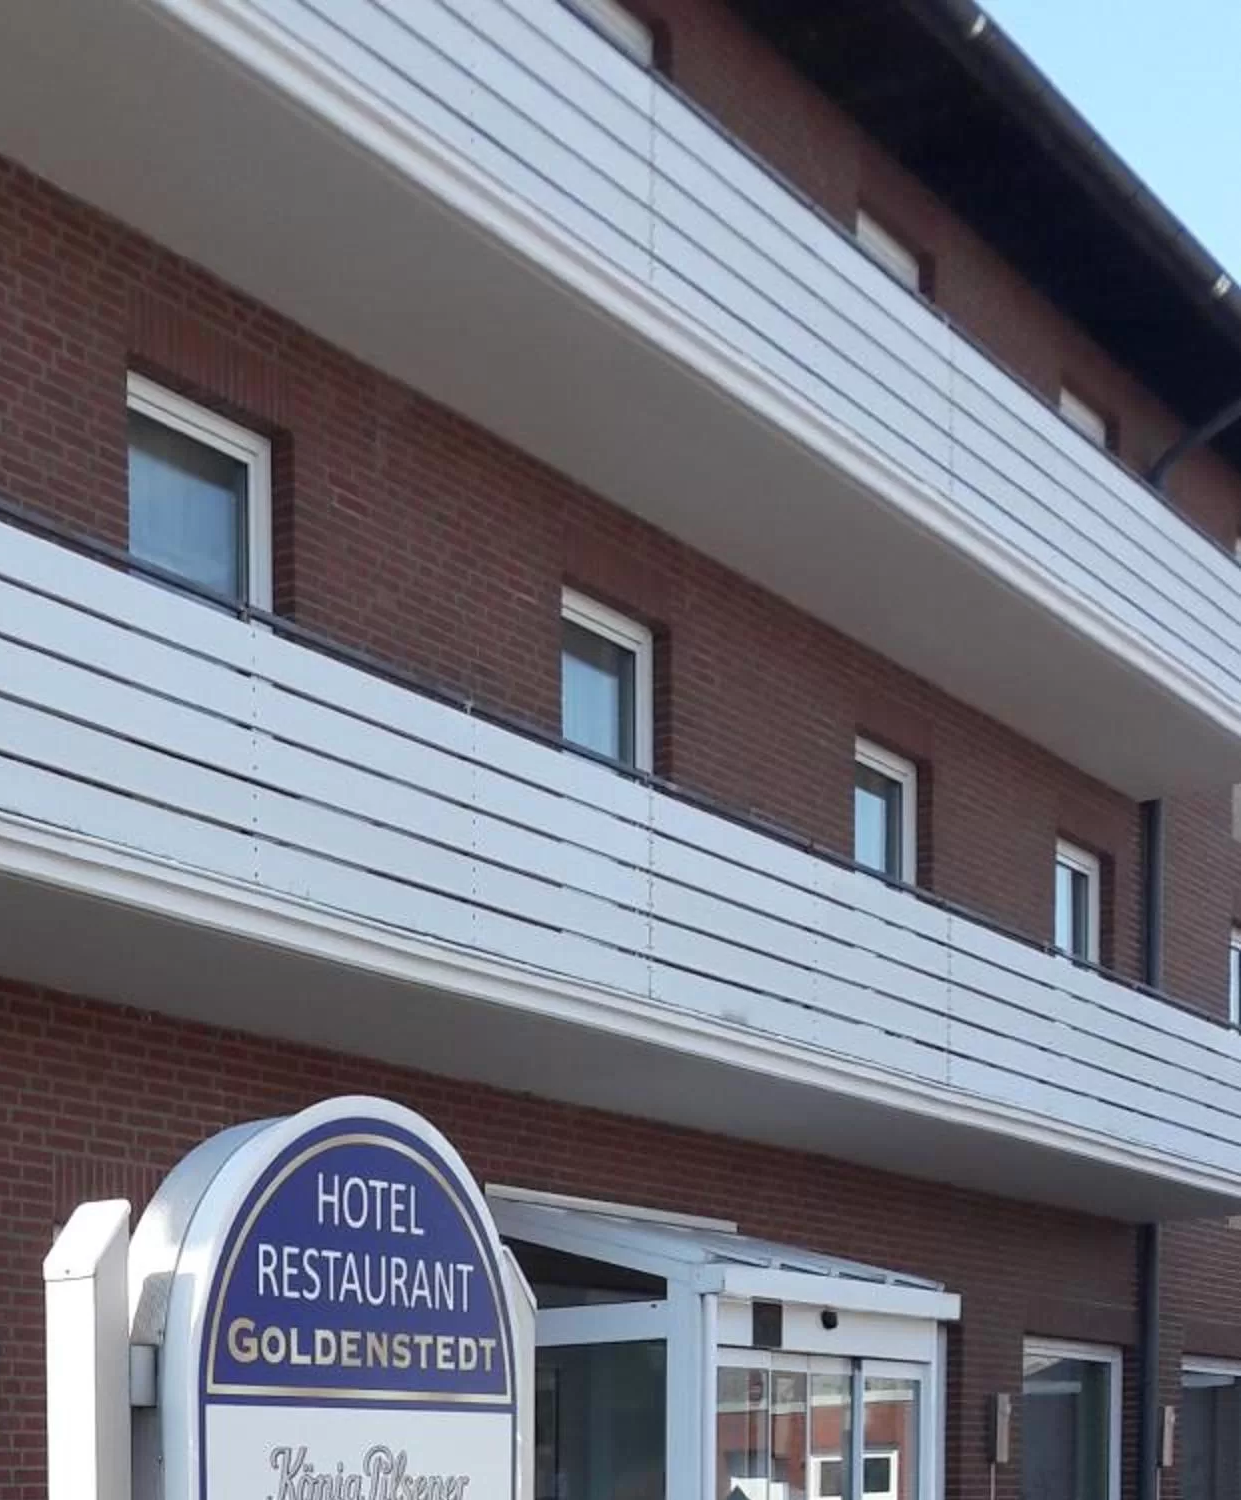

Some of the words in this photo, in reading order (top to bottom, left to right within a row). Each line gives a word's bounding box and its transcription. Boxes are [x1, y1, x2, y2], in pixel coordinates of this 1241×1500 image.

[317, 1172, 424, 1236] HOTEL
[258, 1244, 474, 1313] RESTAURANT
[227, 1317, 497, 1372] GOLDENSTEDT
